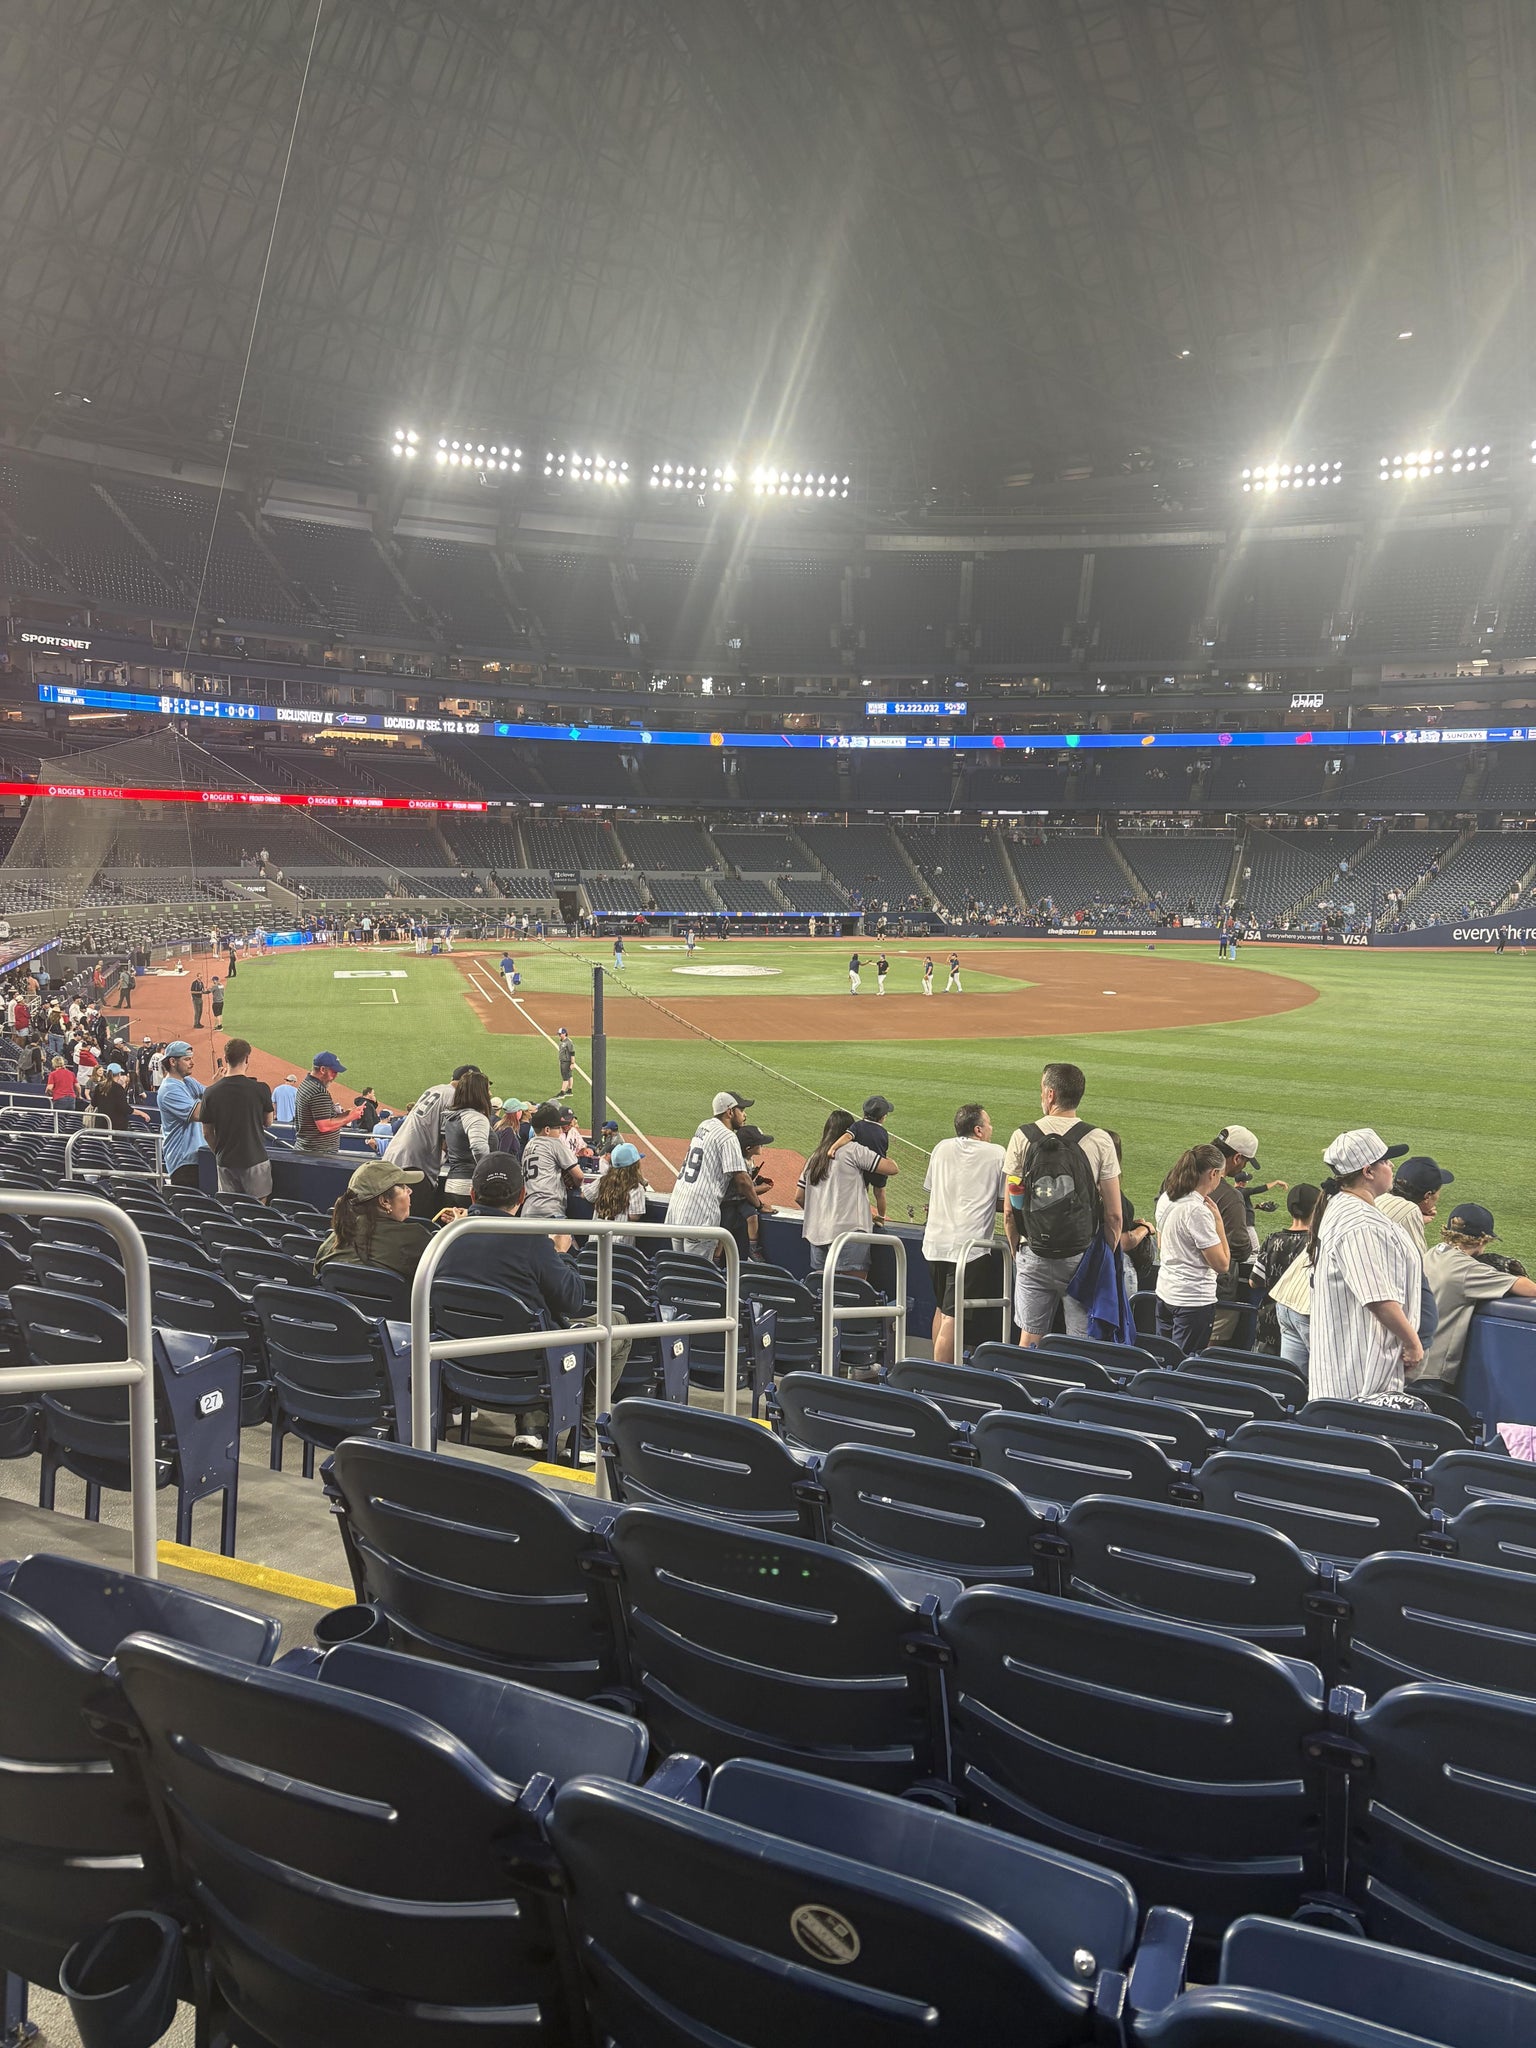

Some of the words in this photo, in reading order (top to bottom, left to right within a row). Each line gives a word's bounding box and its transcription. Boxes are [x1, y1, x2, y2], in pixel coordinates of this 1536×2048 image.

[21, 633, 91, 649] SPORTSNET
[1291, 698, 1323, 708] KPMG
[277, 709, 323, 723] EXCLUSIVELY
[324, 712, 334, 724] AT
[384, 717, 415, 729] LOCATED
[416, 719, 425, 730] AT
[426, 720, 442, 731] SEC.
[443, 721, 455, 732] 112
[456, 722, 464, 733] &
[465, 723, 479, 734] 123
[57, 788, 86, 796] ROGERS
[88, 789, 124, 797] TERRACE
[209, 793, 234, 801] ROGERS
[315, 797, 338, 805] ROGERS
[1242, 930, 1262, 940] ISA
[1341, 934, 1368, 945] VISA
[565, 1356, 575, 1368] 25
[204, 1394, 218, 1410] 27
